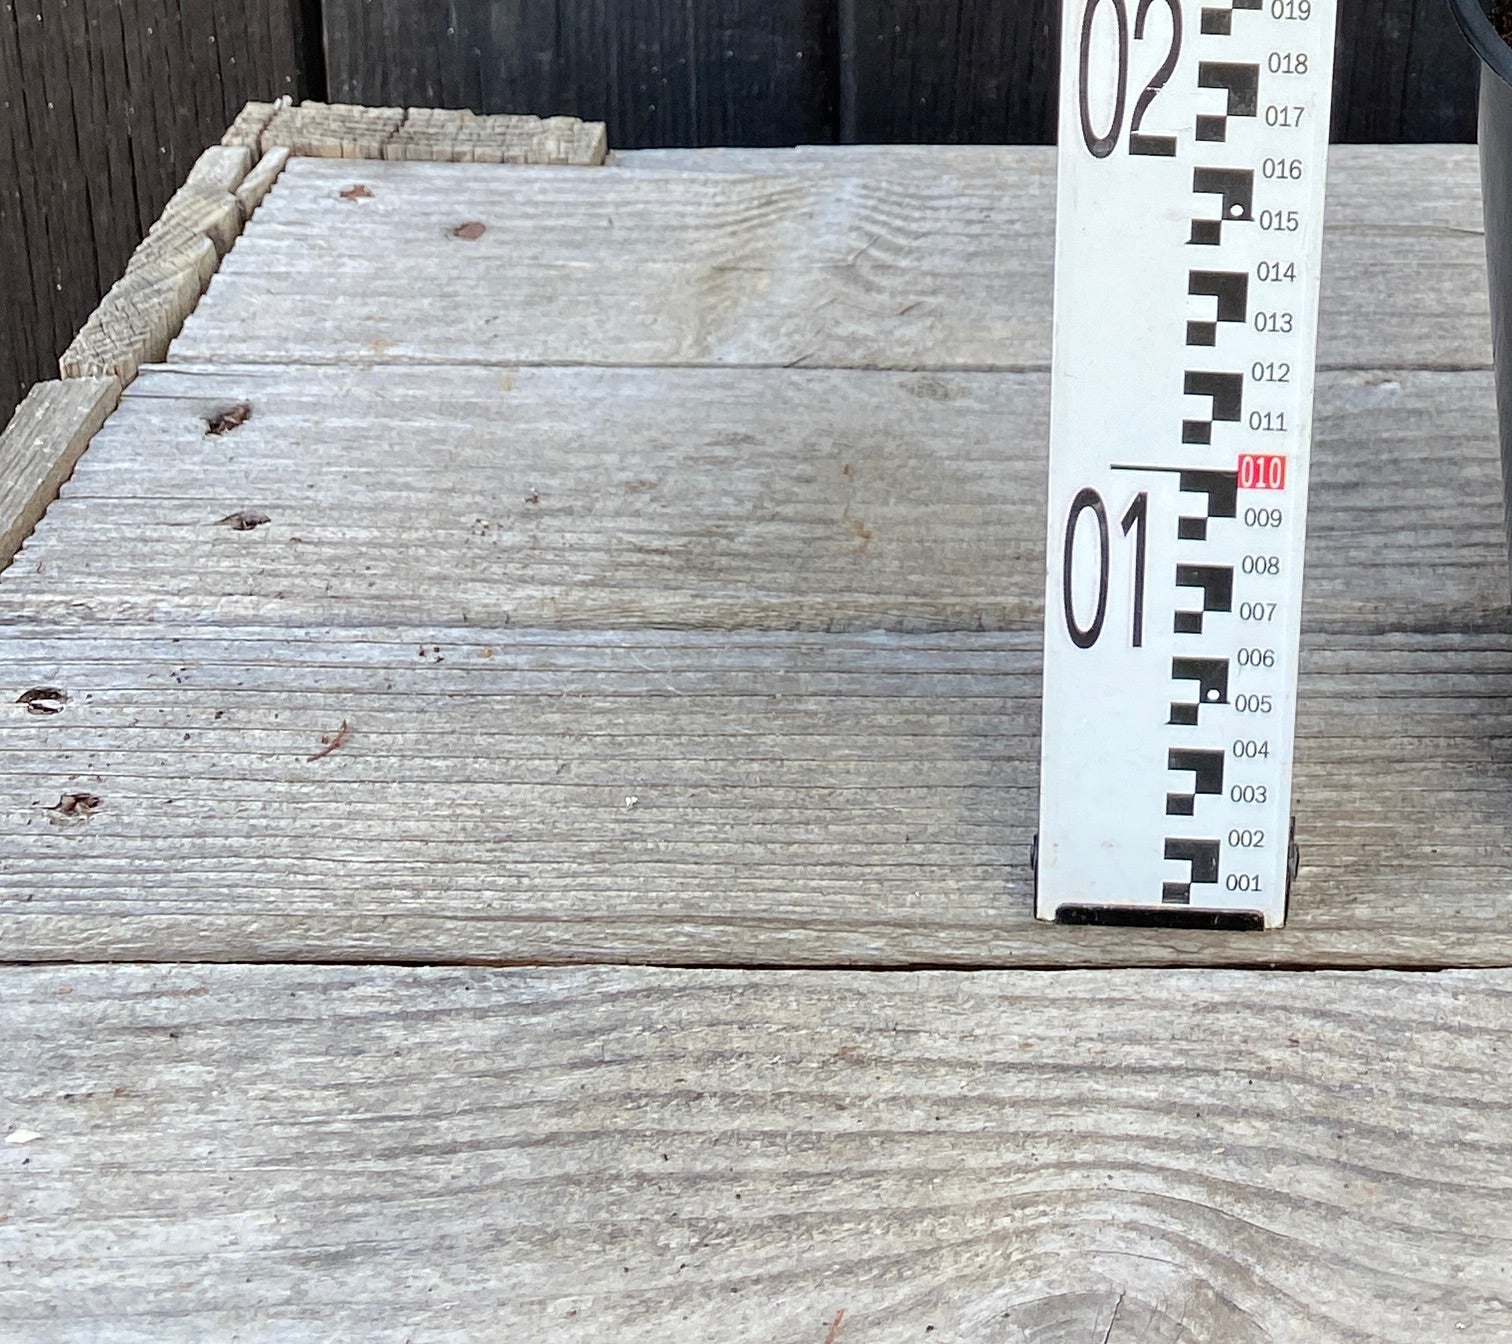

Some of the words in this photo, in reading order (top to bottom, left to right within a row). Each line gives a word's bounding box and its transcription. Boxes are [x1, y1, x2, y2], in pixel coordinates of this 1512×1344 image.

[1268, 52, 1307, 74] 018
[1266, 106, 1304, 127] 017
[1263, 158, 1302, 179] 016
[1260, 210, 1298, 231] 015
[1257, 261, 1296, 282] 014
[1254, 312, 1292, 333] 013
[1252, 362, 1290, 382] 012
[1249, 411, 1287, 432] 011
[1240, 458, 1282, 487] 010
[1244, 508, 1282, 527] 009
[1064, 488, 1148, 648] 01
[1242, 556, 1279, 575] 008
[1240, 602, 1277, 621] 007
[1238, 648, 1274, 667] 006
[1235, 694, 1272, 713] 005
[1233, 740, 1269, 758] 004
[1231, 785, 1266, 803] 003
[1228, 830, 1264, 847] 002
[1226, 874, 1262, 891] 001
